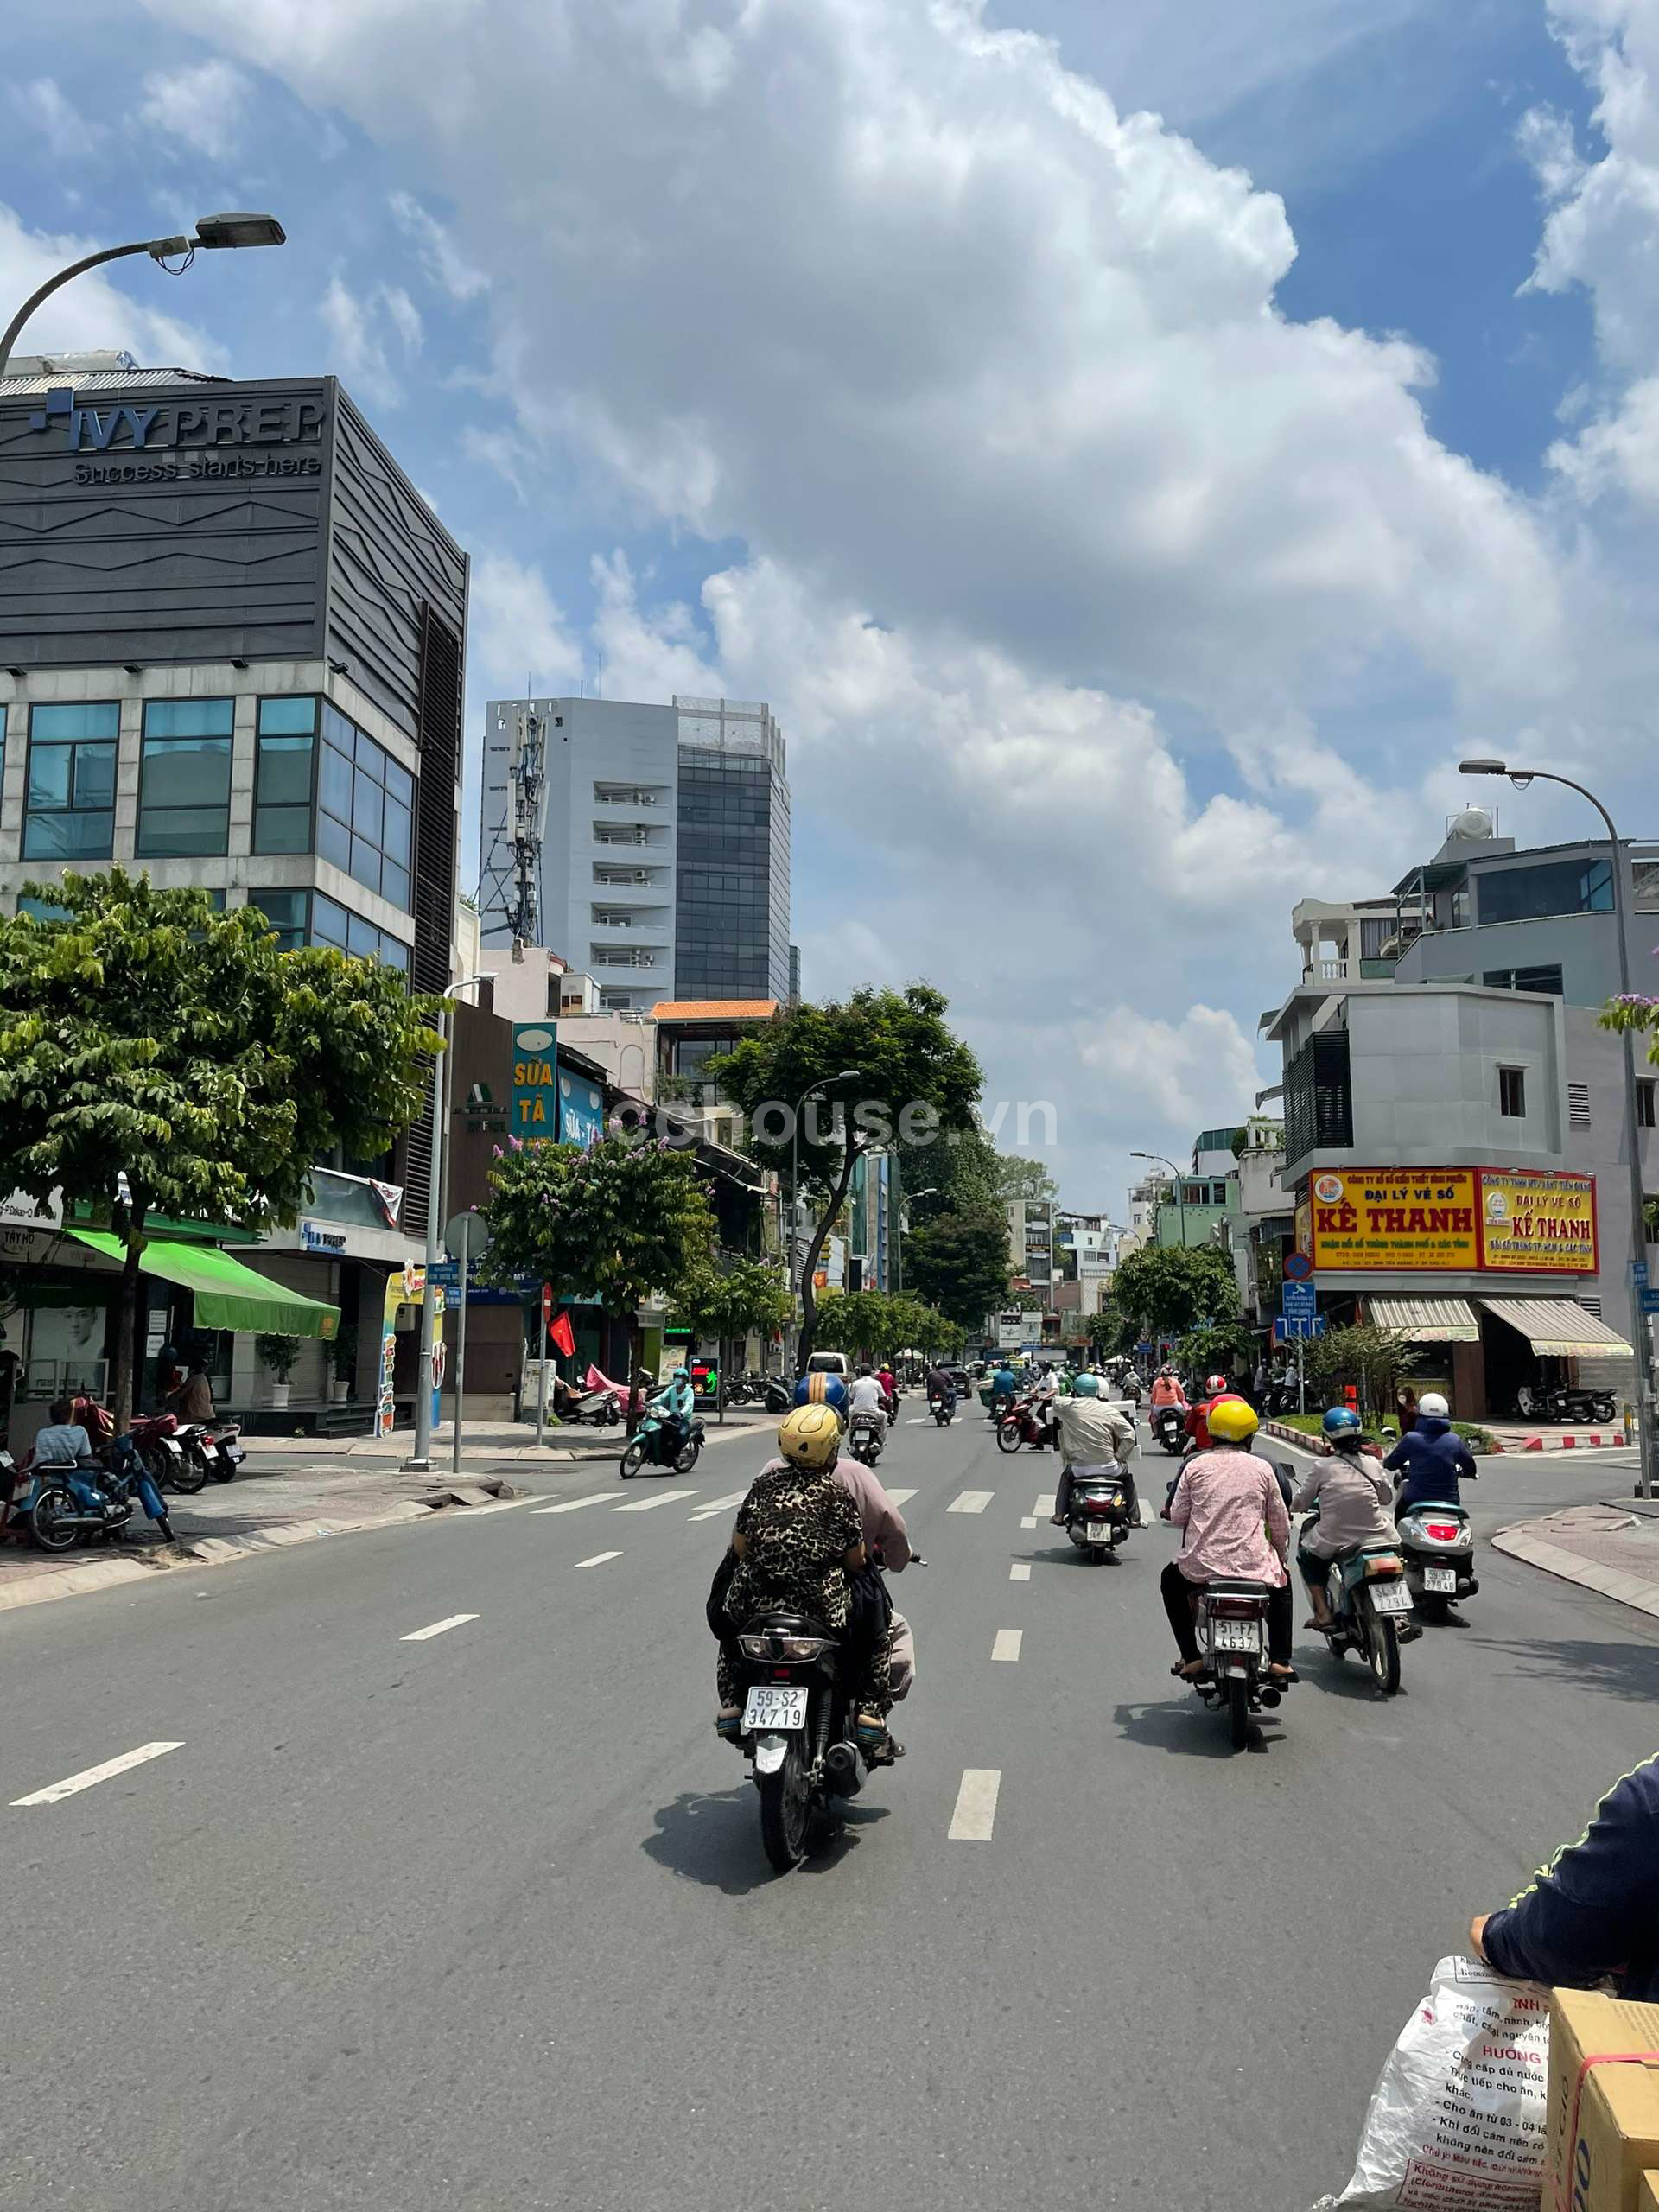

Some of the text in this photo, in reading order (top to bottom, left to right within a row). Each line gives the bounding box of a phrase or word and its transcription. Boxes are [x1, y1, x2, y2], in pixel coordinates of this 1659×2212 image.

[69, 403, 325, 451] IVY PREP
[73, 452, 321, 485] Success starts here
[1365, 1184, 1454, 1203] ĐẠI LÝ VÉ SỐ
[1366, 1208, 1473, 1233] THANH
[1512, 1209, 1591, 1239] KẾ THANH
[757, 1690, 798, 1707] 59-S2
[748, 1708, 801, 1726] 347.19
[1482, 2044, 1541, 2064] HƯỚNG
[1471, 2076, 1492, 2089] tiếp
[1496, 2082, 1517, 2093] cho
[1475, 2063, 1495, 2075] cấp
[1499, 2066, 1513, 2076] đủ
[1517, 2070, 1544, 2082] nước
[1443, 2100, 1466, 2114] Cho
[1469, 2109, 1483, 2120] ăn
[1487, 2113, 1497, 2124] từ
[1500, 2116, 1512, 2127] 03
[1522, 2121, 1535, 2132] 04
[1440, 2116, 1459, 2130] Khi
[1463, 2124, 1480, 2136] đổi
[1510, 2137, 1529, 2147] nên
[1436, 2133, 1471, 2152] không
[1474, 2145, 1494, 2155] nên
[1497, 2150, 1515, 2160] đổi
